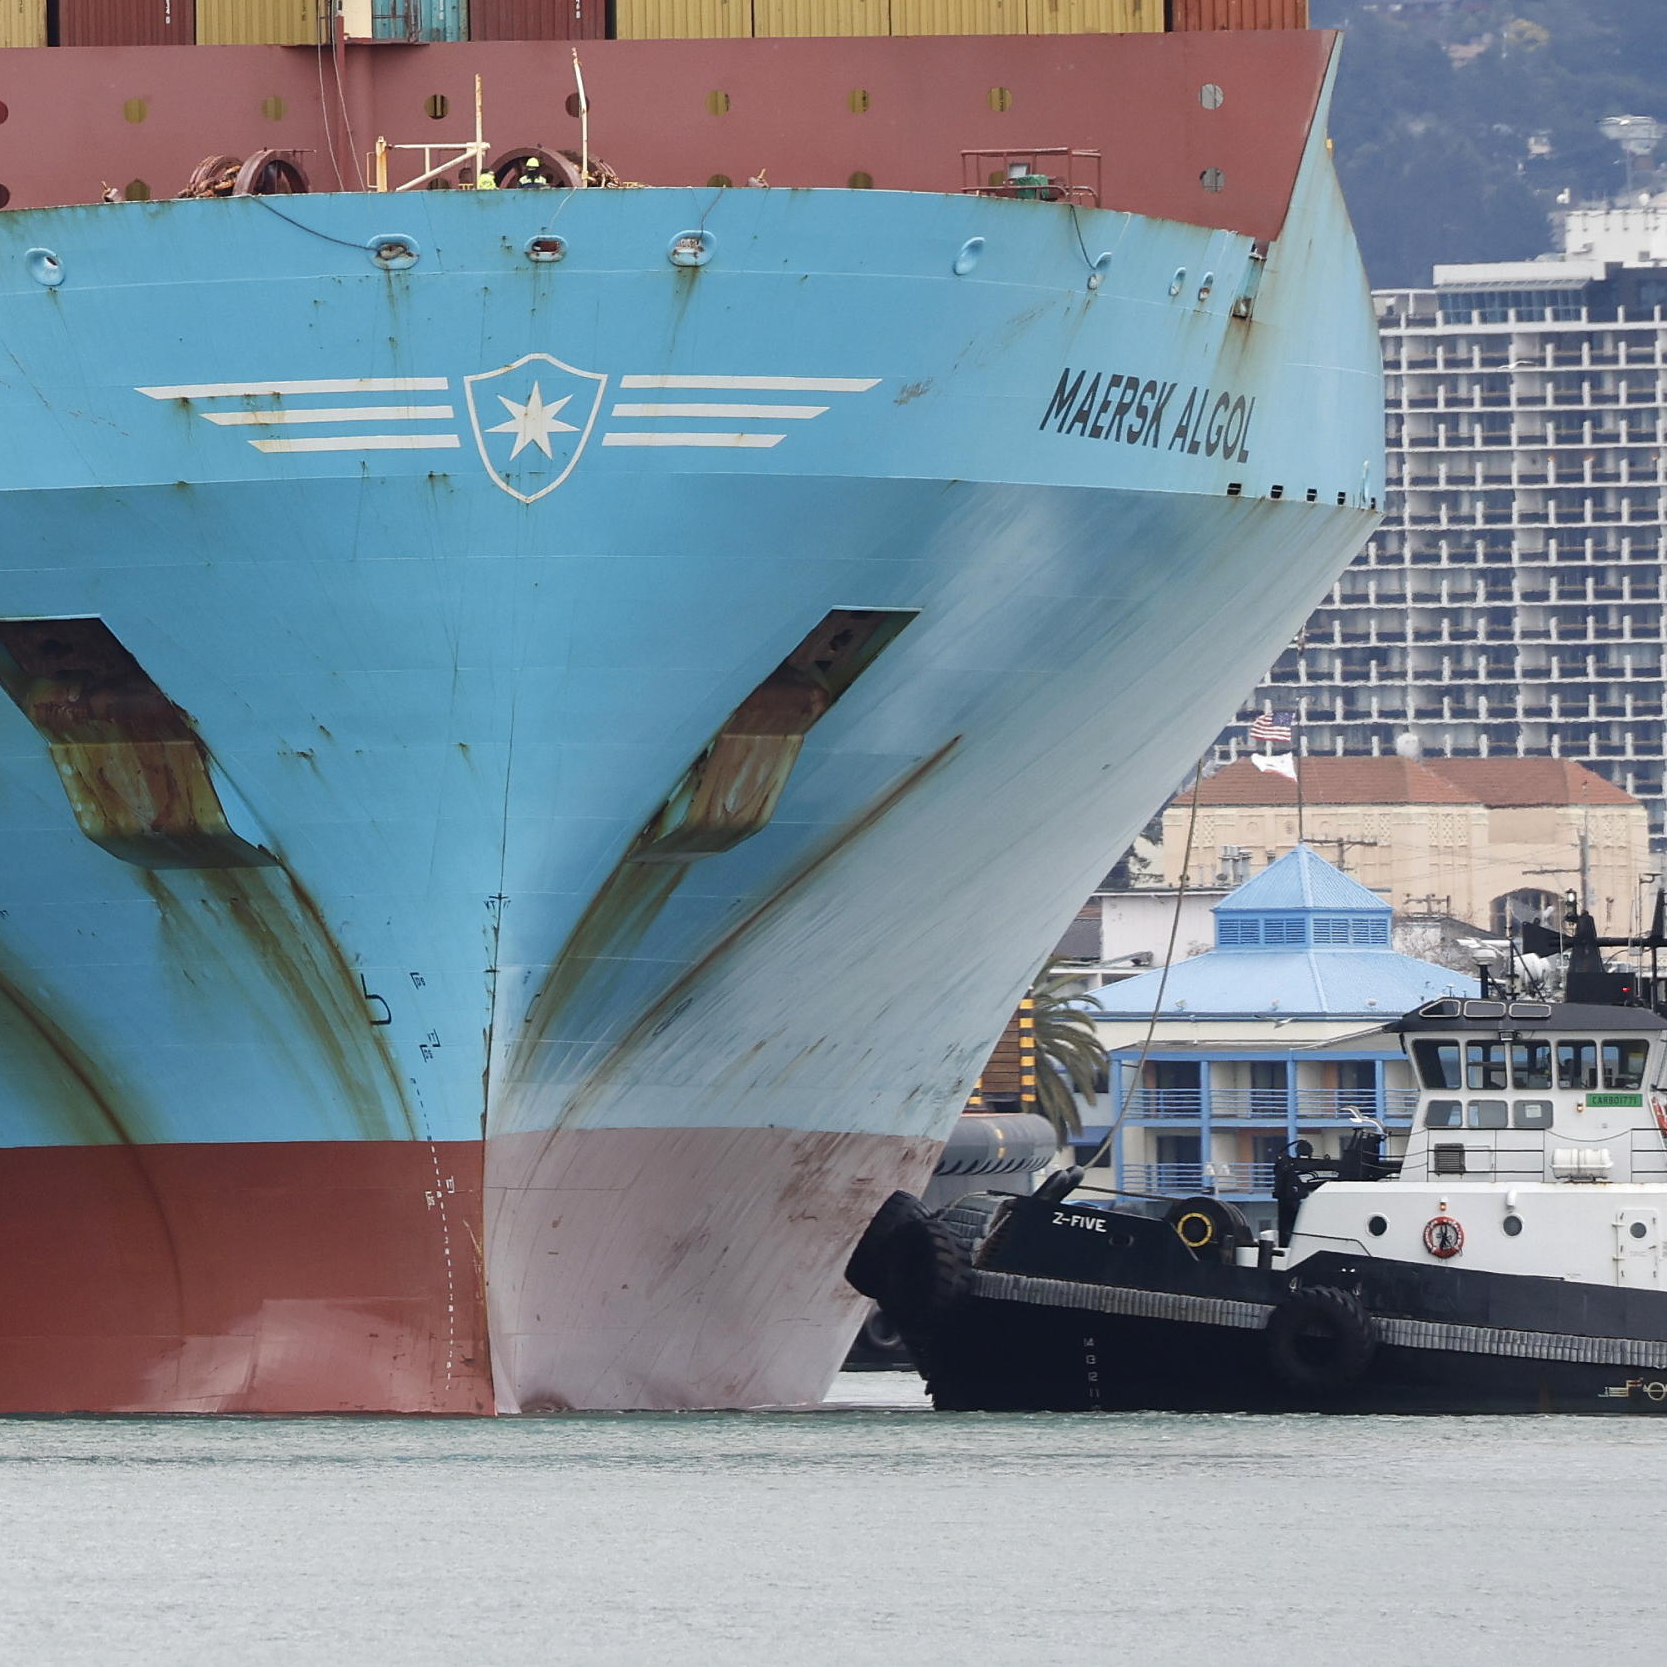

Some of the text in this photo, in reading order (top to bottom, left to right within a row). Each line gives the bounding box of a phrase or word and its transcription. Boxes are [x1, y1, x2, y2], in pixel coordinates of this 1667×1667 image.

[1039, 367, 1256, 463] MAERSK ALGOL
[1052, 1211, 1108, 1233] Z-FIVE
